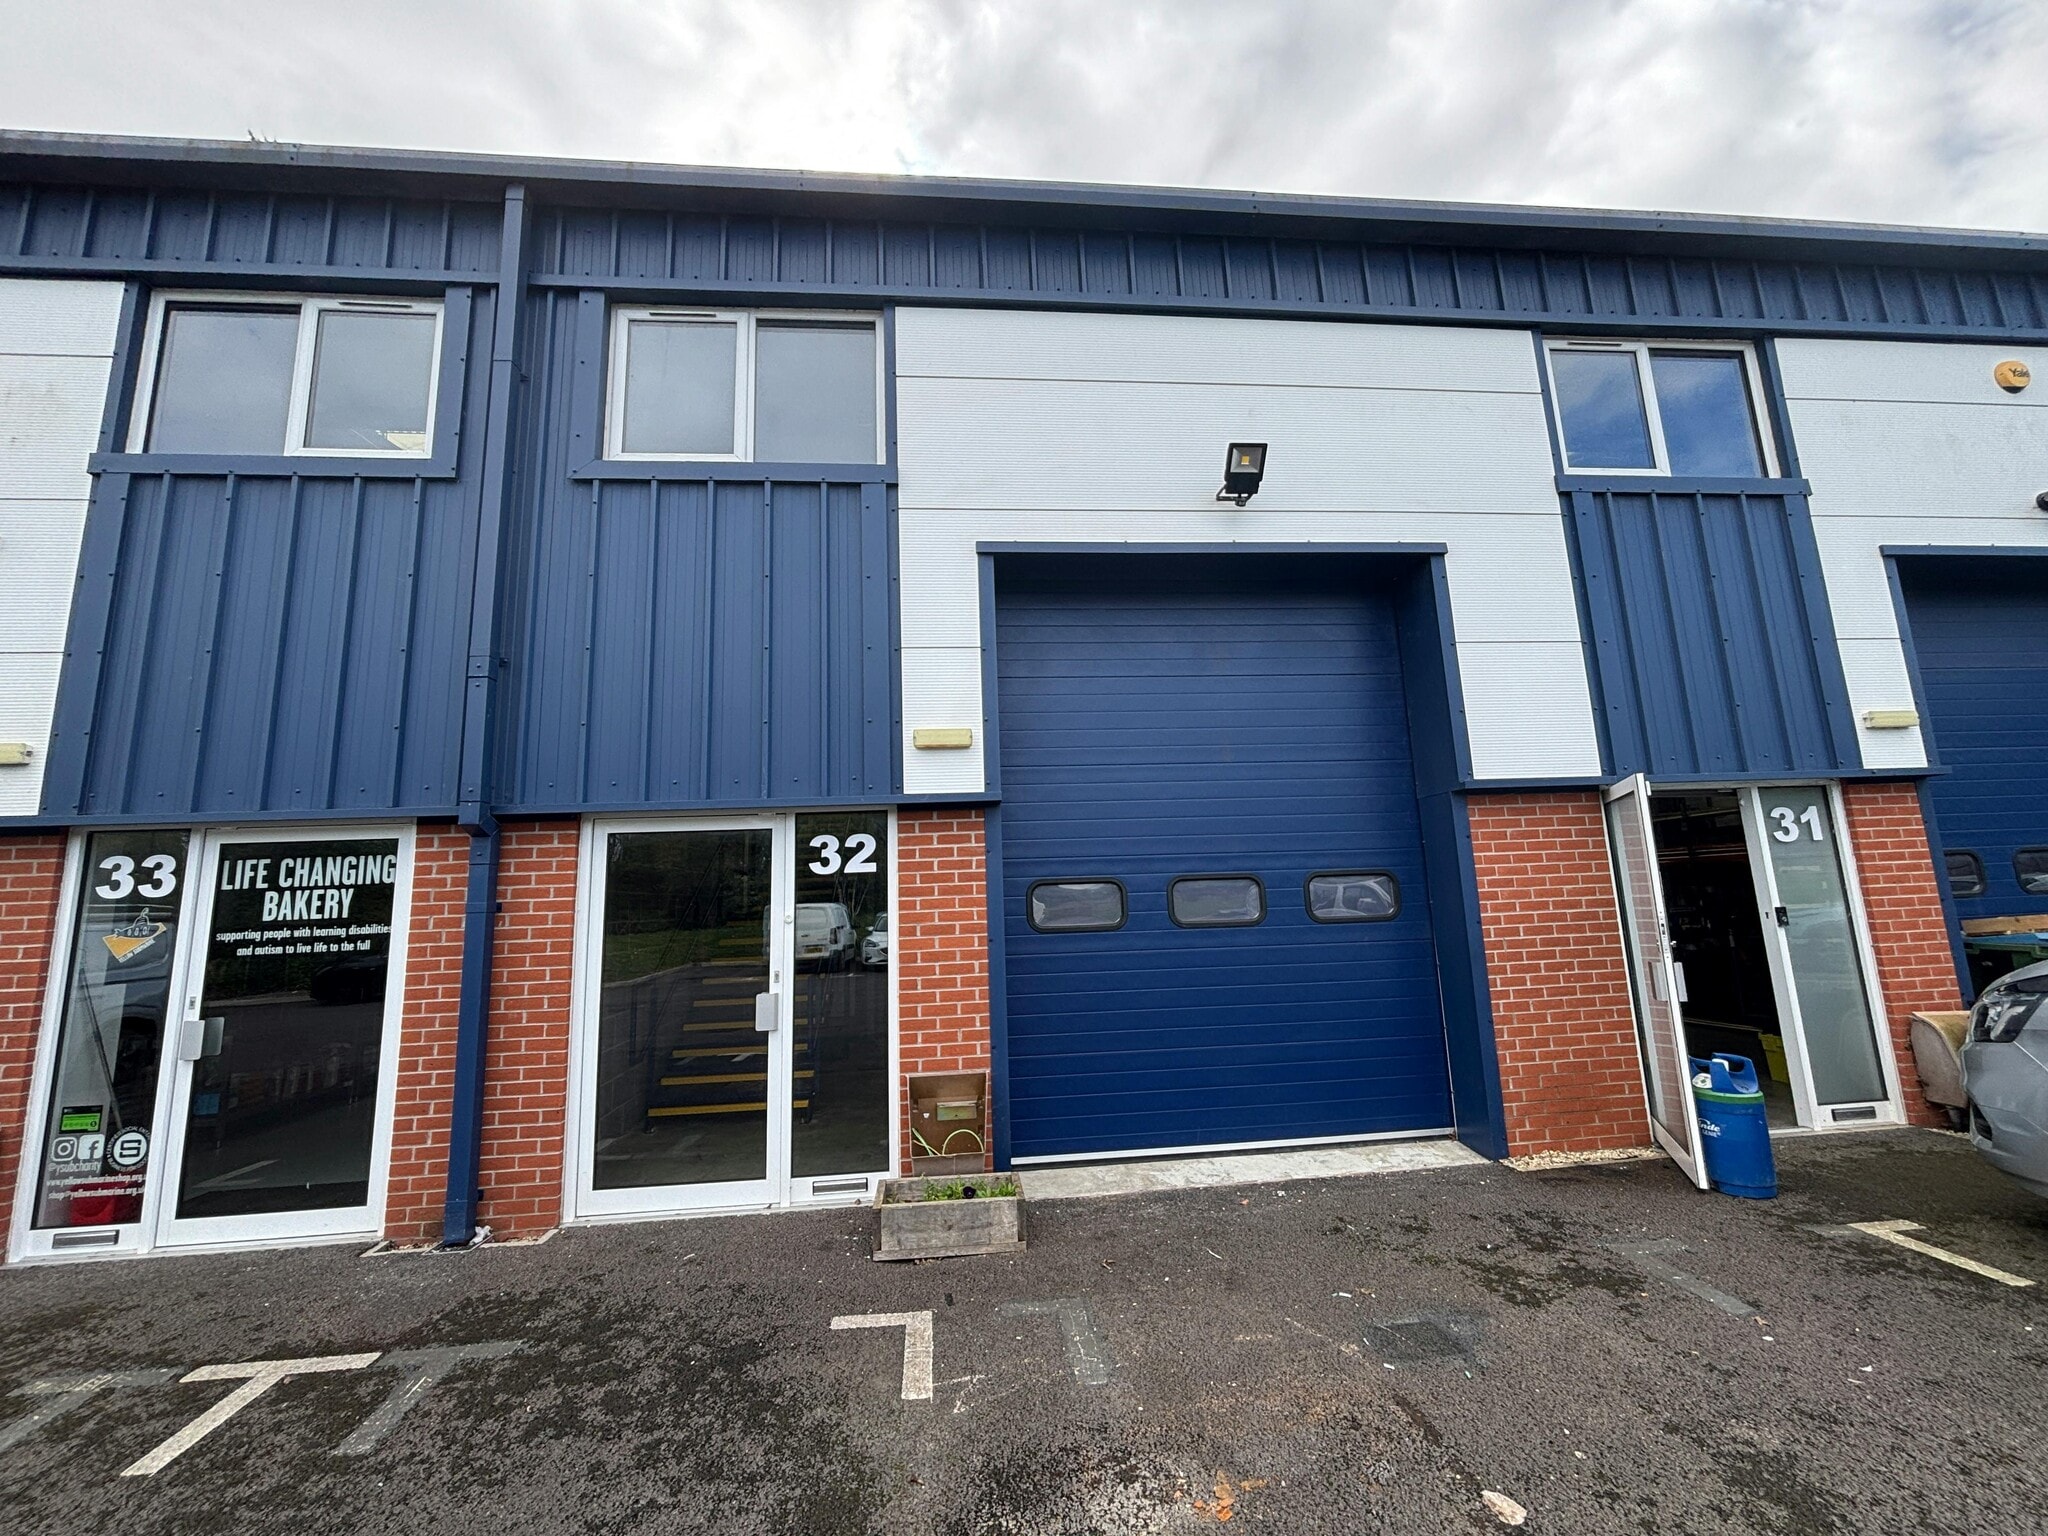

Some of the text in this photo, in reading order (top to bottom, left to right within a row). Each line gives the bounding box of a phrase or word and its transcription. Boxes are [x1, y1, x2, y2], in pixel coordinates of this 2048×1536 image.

[1769, 805, 1823, 843] 31
[221, 854, 396, 890] LIFE CHANGING
[808, 833, 877, 875] 32
[95, 854, 177, 899] 33
[262, 888, 354, 921] BAKERY
[216, 928, 261, 943] supporting
[263, 927, 291, 941] people
[294, 926, 311, 937] with
[313, 925, 346, 938] learning
[236, 939, 371, 956] and autism to live life to the full
